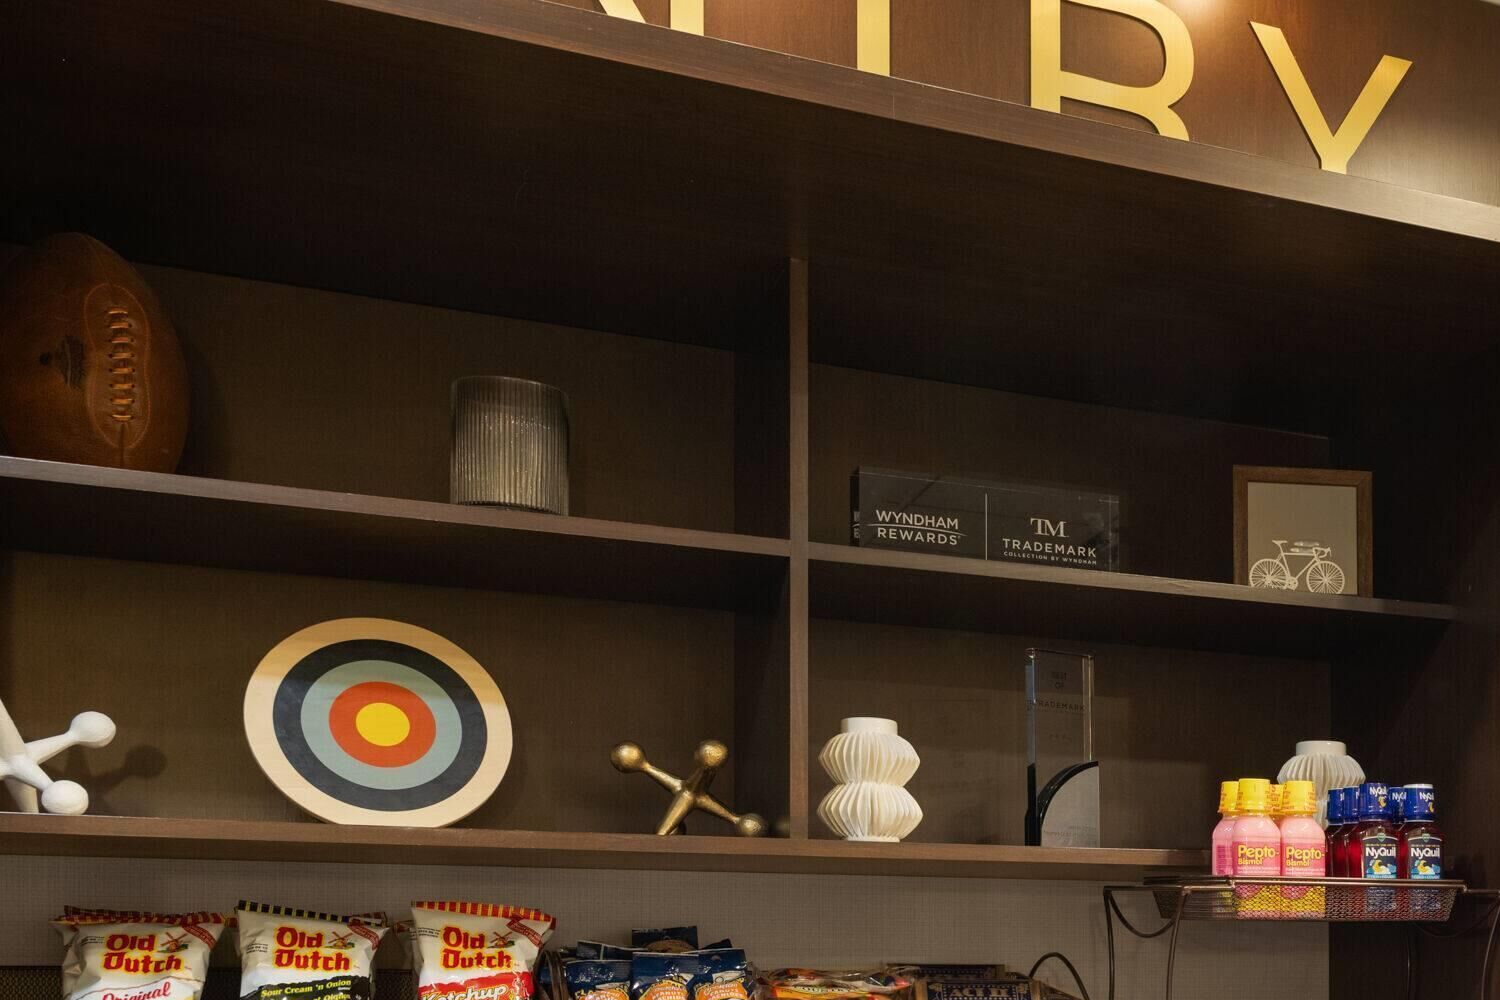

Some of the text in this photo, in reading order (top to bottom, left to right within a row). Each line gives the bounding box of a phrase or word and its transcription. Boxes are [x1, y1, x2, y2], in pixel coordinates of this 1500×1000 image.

[876, 509, 959, 530] WYNDHAM
[1030, 517, 1070, 538] TM
[877, 527, 960, 546] REWARDS
[1002, 538, 1097, 558] TRADEMARK
[1003, 551, 1048, 561] COLLECTION
[1062, 557, 1097, 566] WYNDHAM
[1365, 847, 1396, 859] NyQuil
[1410, 848, 1440, 859] NyQuil
[106, 934, 157, 952] Old
[276, 926, 324, 948] Old
[443, 926, 485, 949] Old
[103, 951, 182, 973] Dutch
[274, 949, 350, 971] Dutch
[442, 949, 511, 969] Dutch
[261, 987, 282, 997] Sour
[284, 986, 313, 995] Cream
[326, 980, 351, 989] Onion
